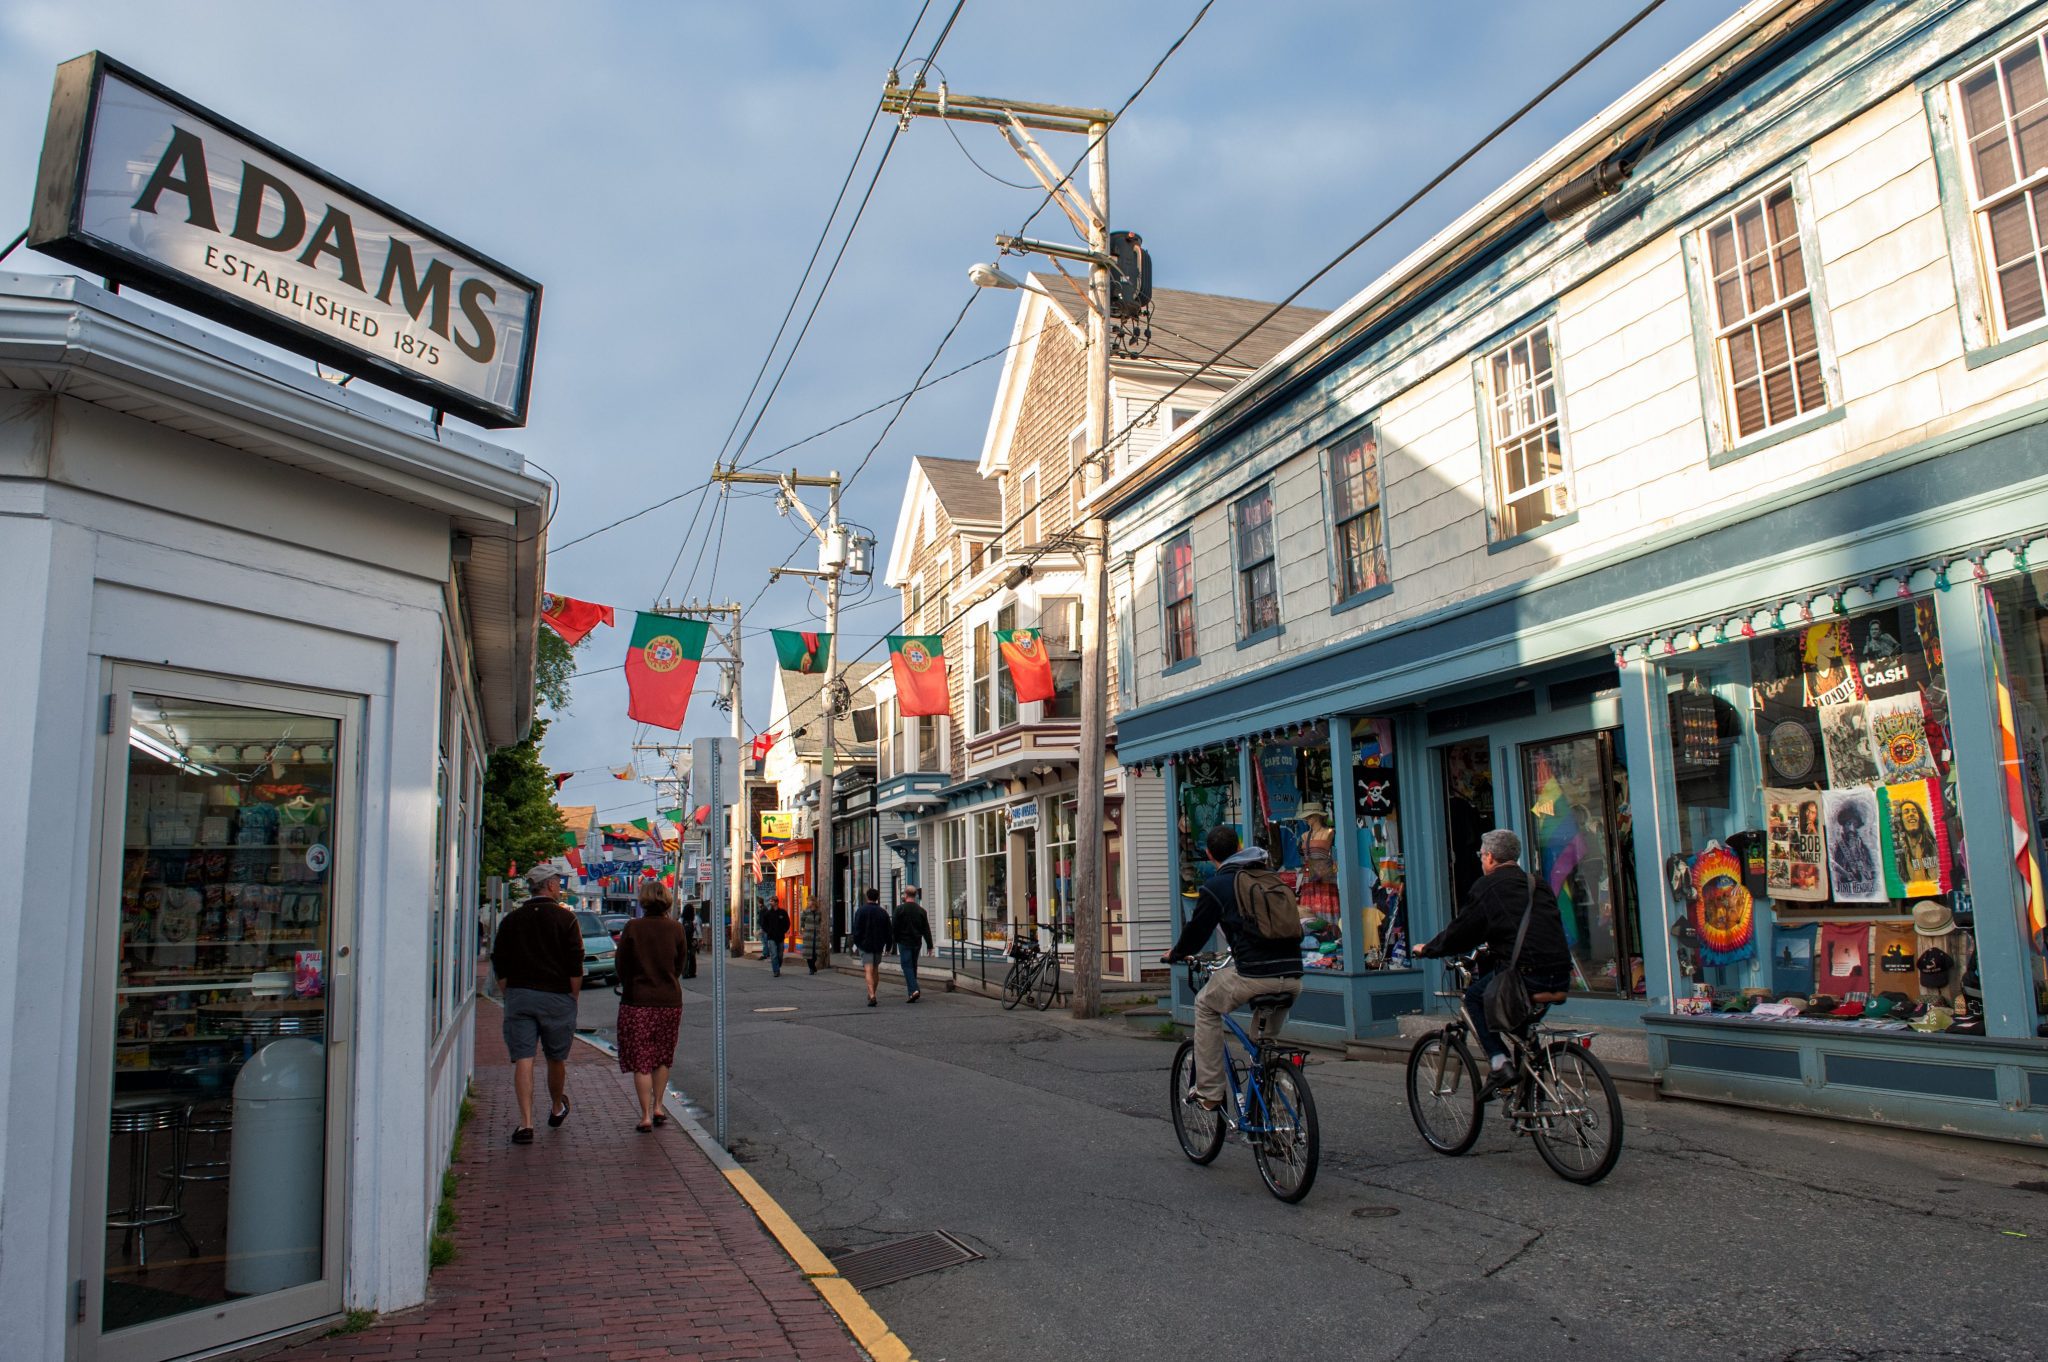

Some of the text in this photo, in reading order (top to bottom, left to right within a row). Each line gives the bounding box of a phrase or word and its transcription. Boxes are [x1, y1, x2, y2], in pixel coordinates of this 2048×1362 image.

[132, 125, 497, 364] ADAMS
[205, 245, 440, 365] ESTABLISHED 1875
[1864, 665, 1909, 687] CASH
[1800, 835, 1821, 852] BOB
[1800, 852, 1821, 863] MARLEY
[1836, 880, 1851, 893] JIMI
[305, 952, 321, 962] PULL
